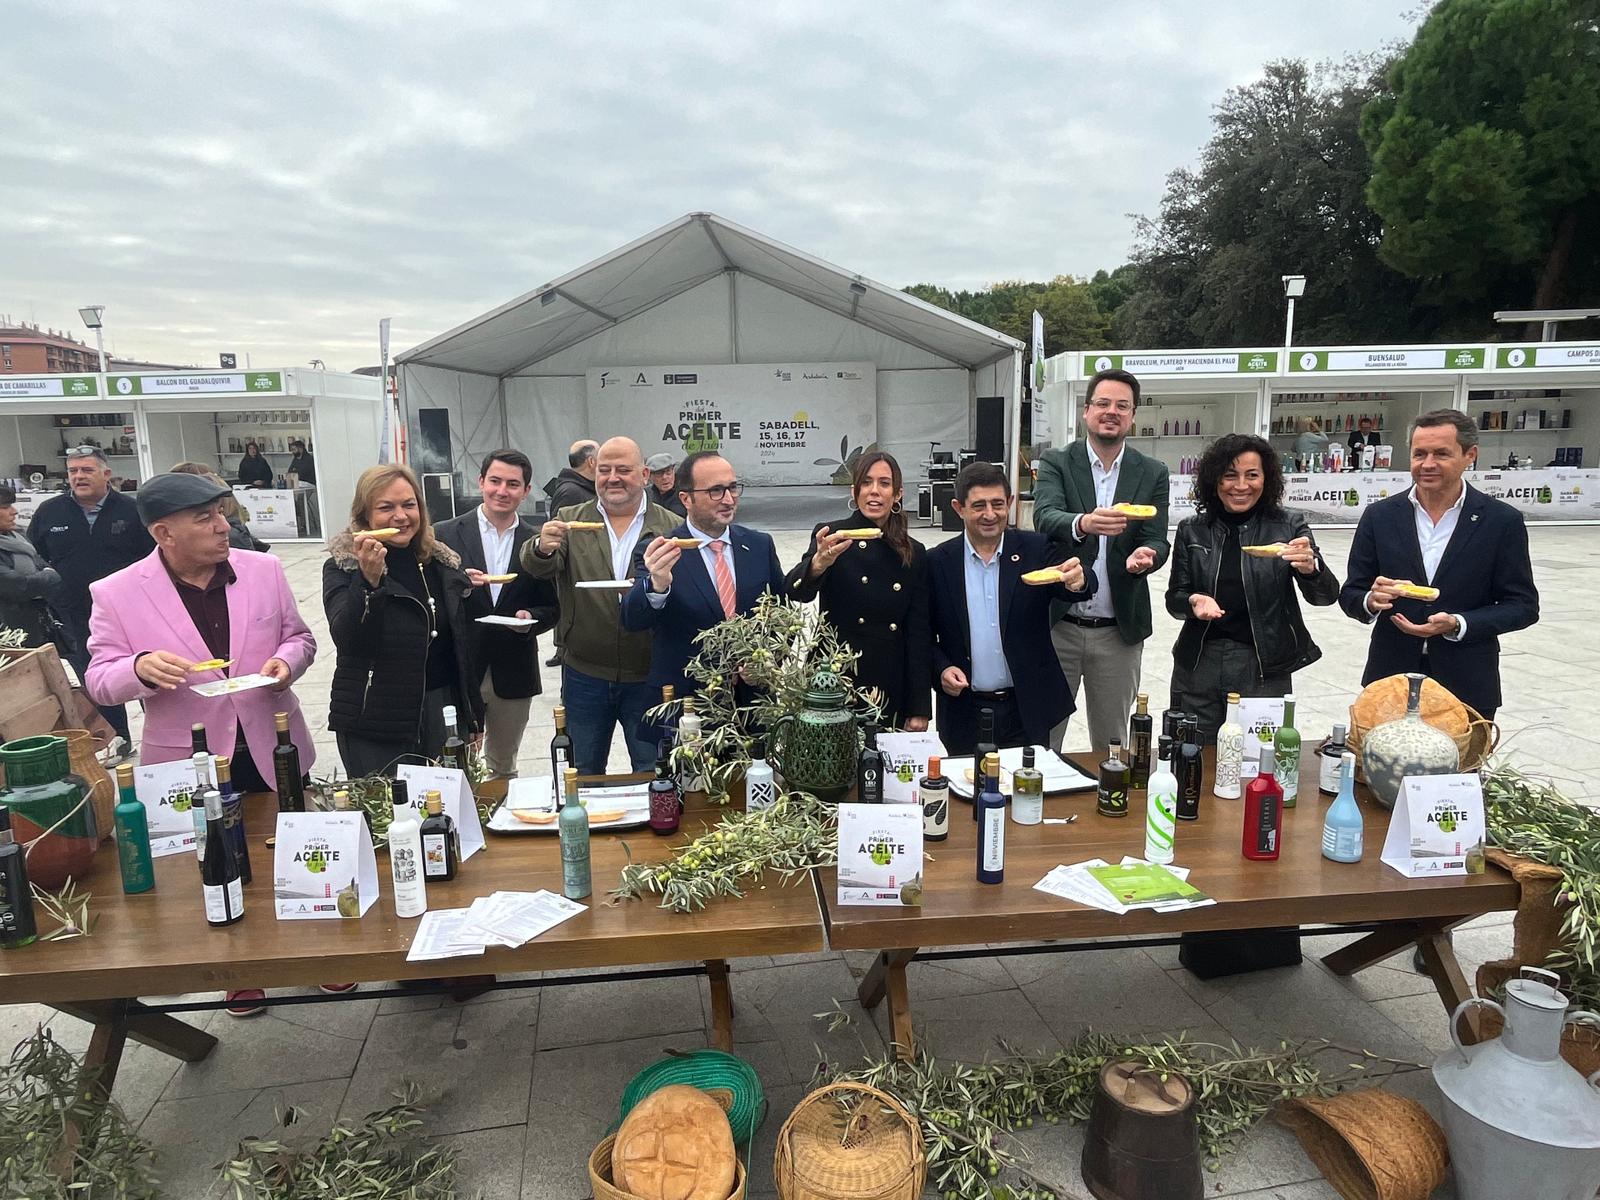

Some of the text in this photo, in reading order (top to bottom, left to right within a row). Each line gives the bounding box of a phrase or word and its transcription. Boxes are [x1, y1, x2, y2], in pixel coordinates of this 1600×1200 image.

[1101, 362, 1106, 370] 6
[190, 377, 231, 385] GUADALQUIVIR
[685, 400, 715, 408] FIESTA
[680, 411, 722, 421] PRIMER
[760, 421, 820, 430] SABADELL,
[662, 422, 742, 441] ACEITE
[760, 432, 806, 440] 15, 16, 17
[1314, 490, 1357, 501] ACEITE
[1506, 487, 1551, 498] ACEITE
[1248, 726, 1280, 735] ACEIT
[887, 764, 924, 774] CEITE
[168, 786, 193, 795] PRIMER
[1427, 811, 1468, 823] ACEITE
[858, 843, 905, 854] ACEITE
[294, 851, 340, 862] ACEITE
